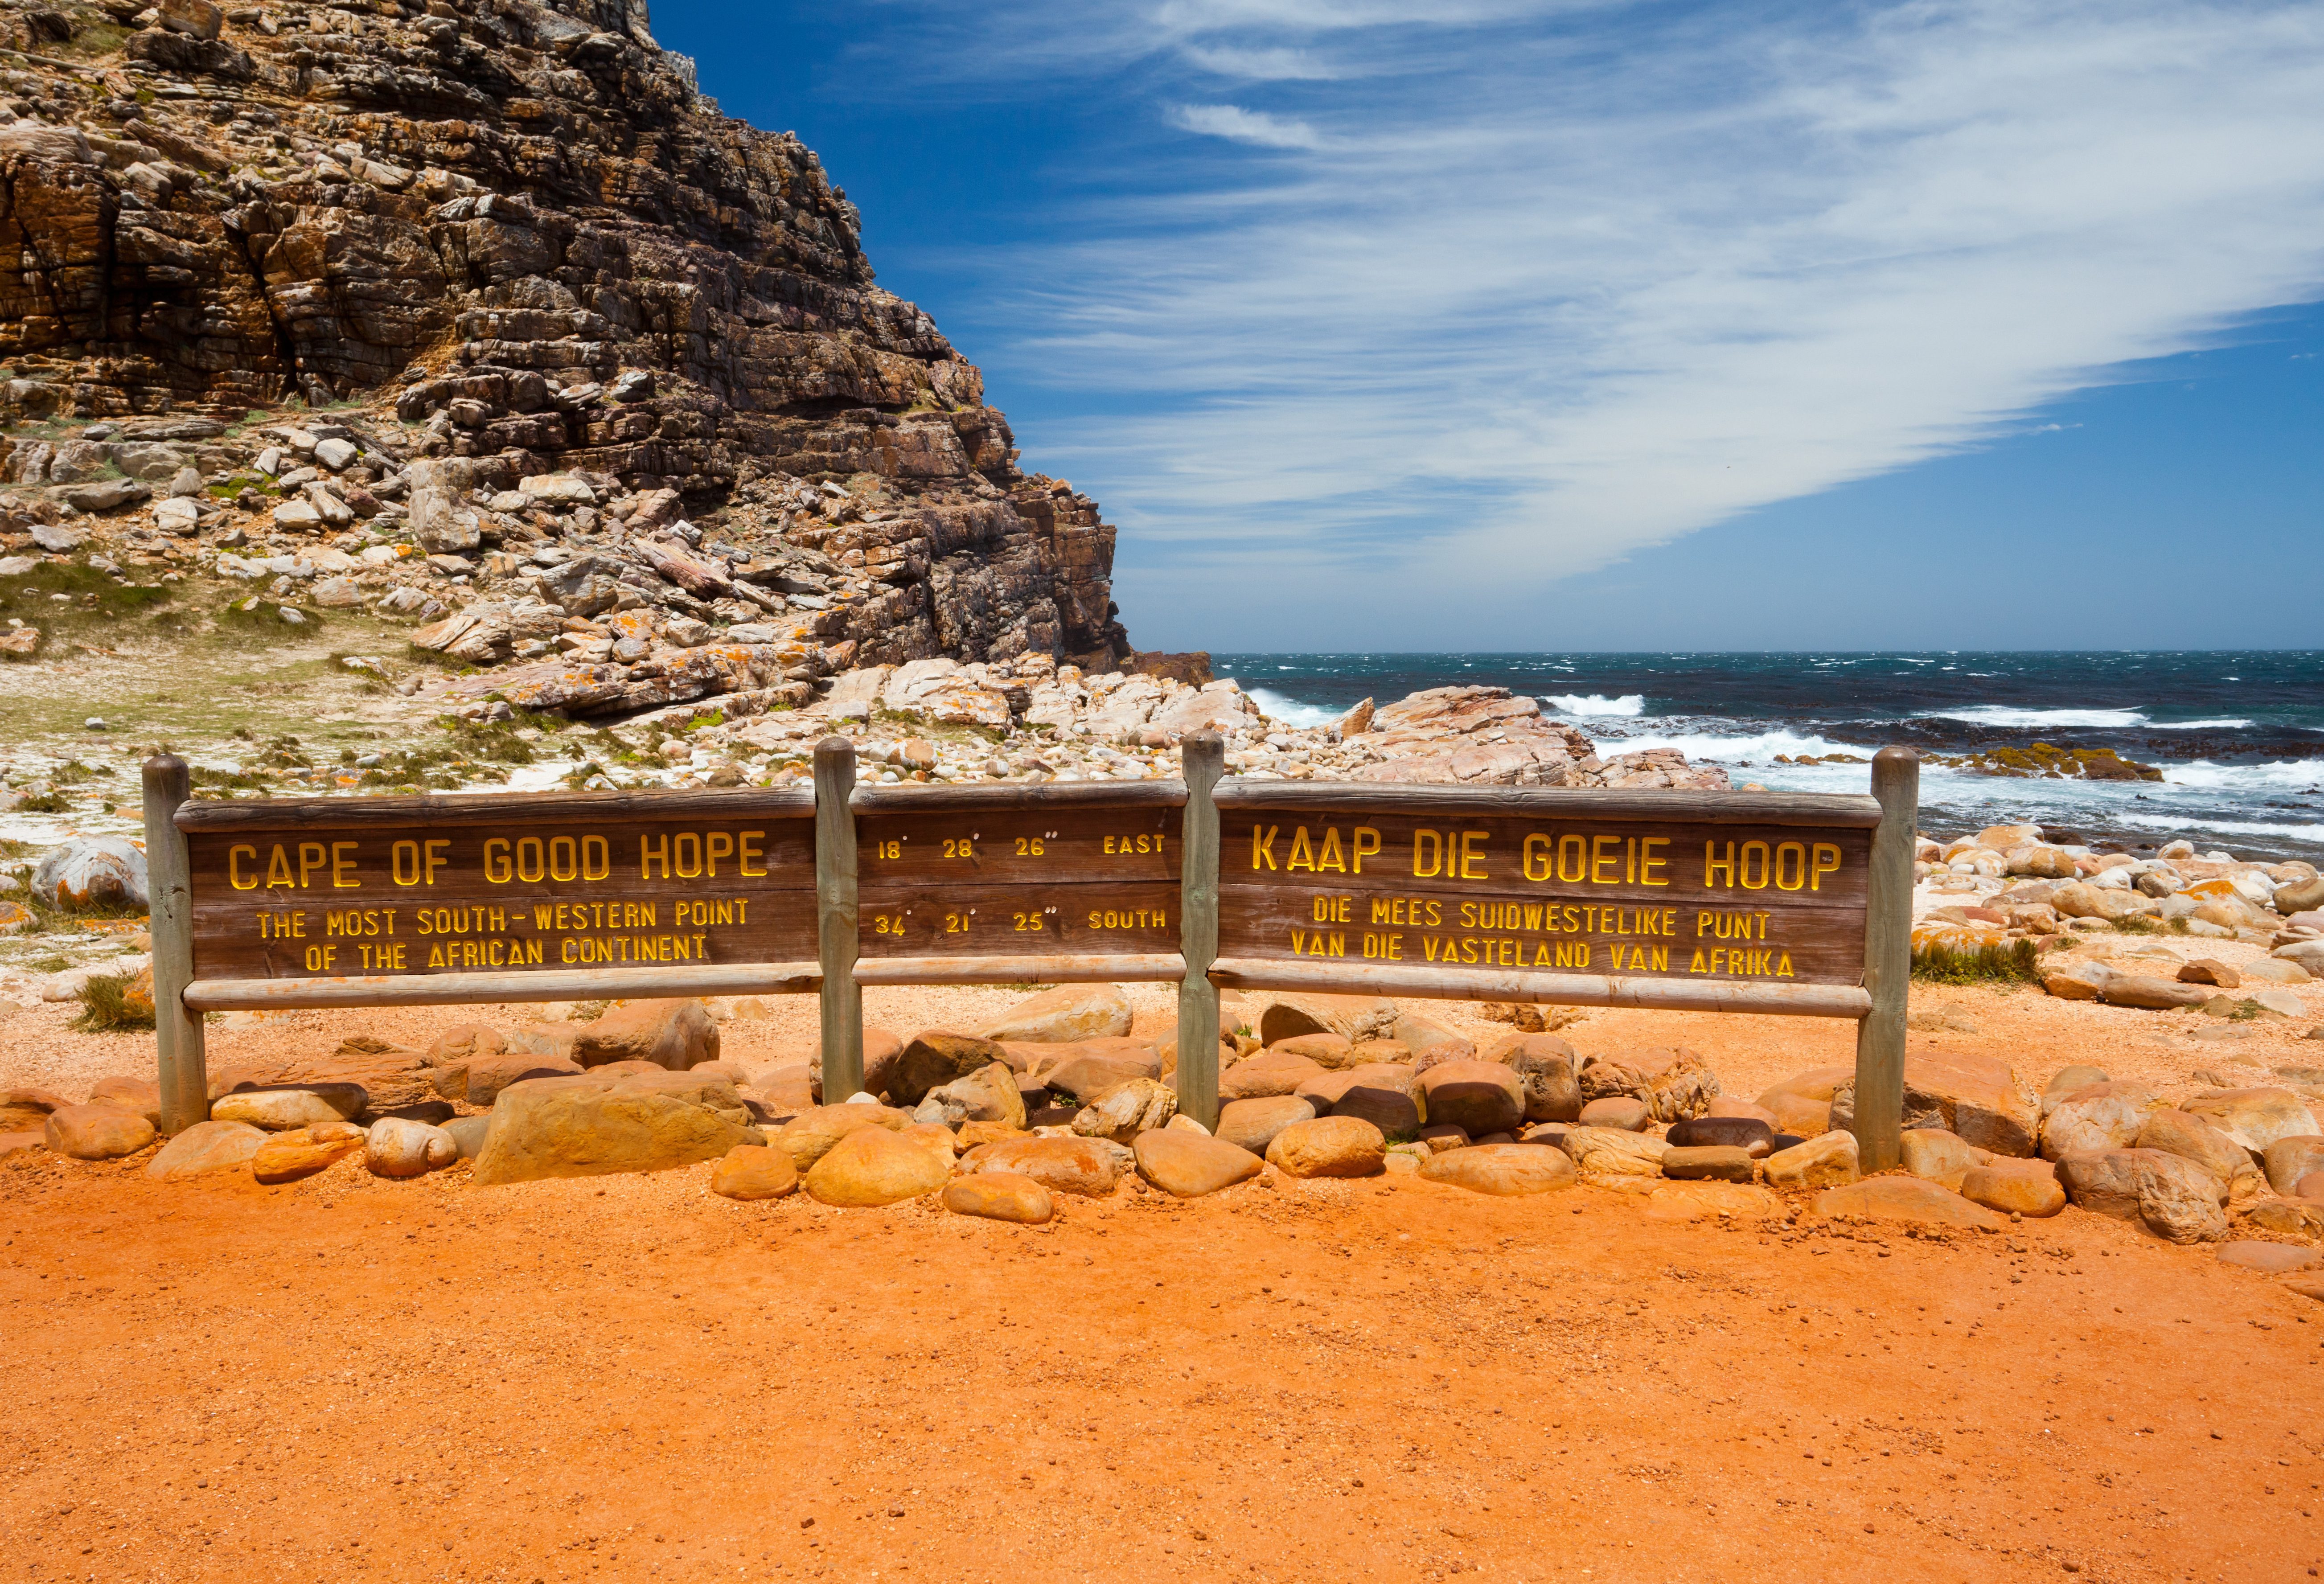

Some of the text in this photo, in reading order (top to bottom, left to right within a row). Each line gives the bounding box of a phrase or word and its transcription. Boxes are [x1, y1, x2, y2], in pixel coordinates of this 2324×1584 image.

[230, 831, 768, 891] CAPE OF GOOD HOPE
[1104, 834, 1165, 854] EAST
[1252, 825, 1841, 891] KAAP DIE GOEIE HOOP
[256, 910, 307, 939] THE
[326, 908, 397, 936] MOST
[674, 898, 748, 926] POINT
[1088, 909, 1166, 930] SOUTH
[1314, 895, 1770, 940] DIE MEES SUIDWESTELIKE PUNT
[305, 933, 706, 971] OF THE AFRICAN CONTINENT
[1292, 929, 1794, 977] VAN DIE VASTELAND VAN AFRIKA
